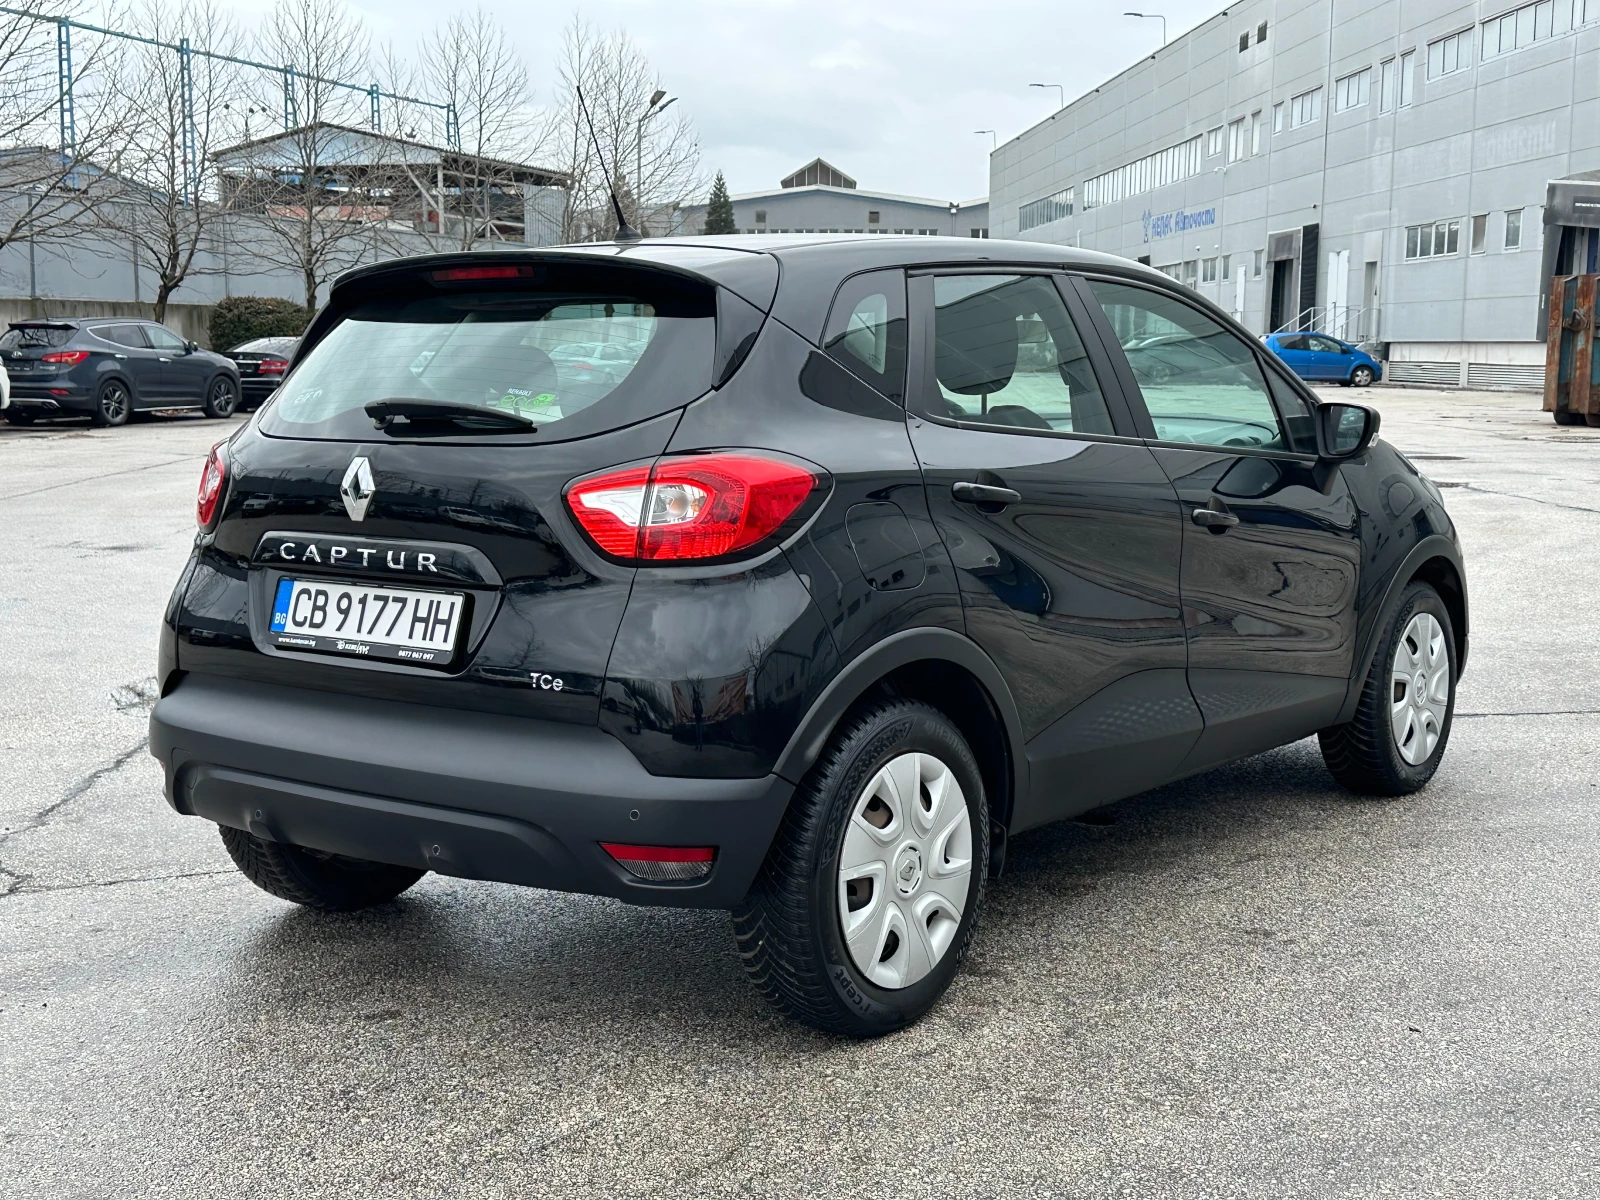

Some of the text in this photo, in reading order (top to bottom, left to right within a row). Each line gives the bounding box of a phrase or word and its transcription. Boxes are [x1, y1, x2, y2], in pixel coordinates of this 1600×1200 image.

[506, 387, 533, 397] RENAULT
[279, 542, 438, 572] CAPTUR
[274, 611, 287, 625] BG
[291, 587, 456, 643] CB 9177 HH
[530, 672, 564, 691] TCe
